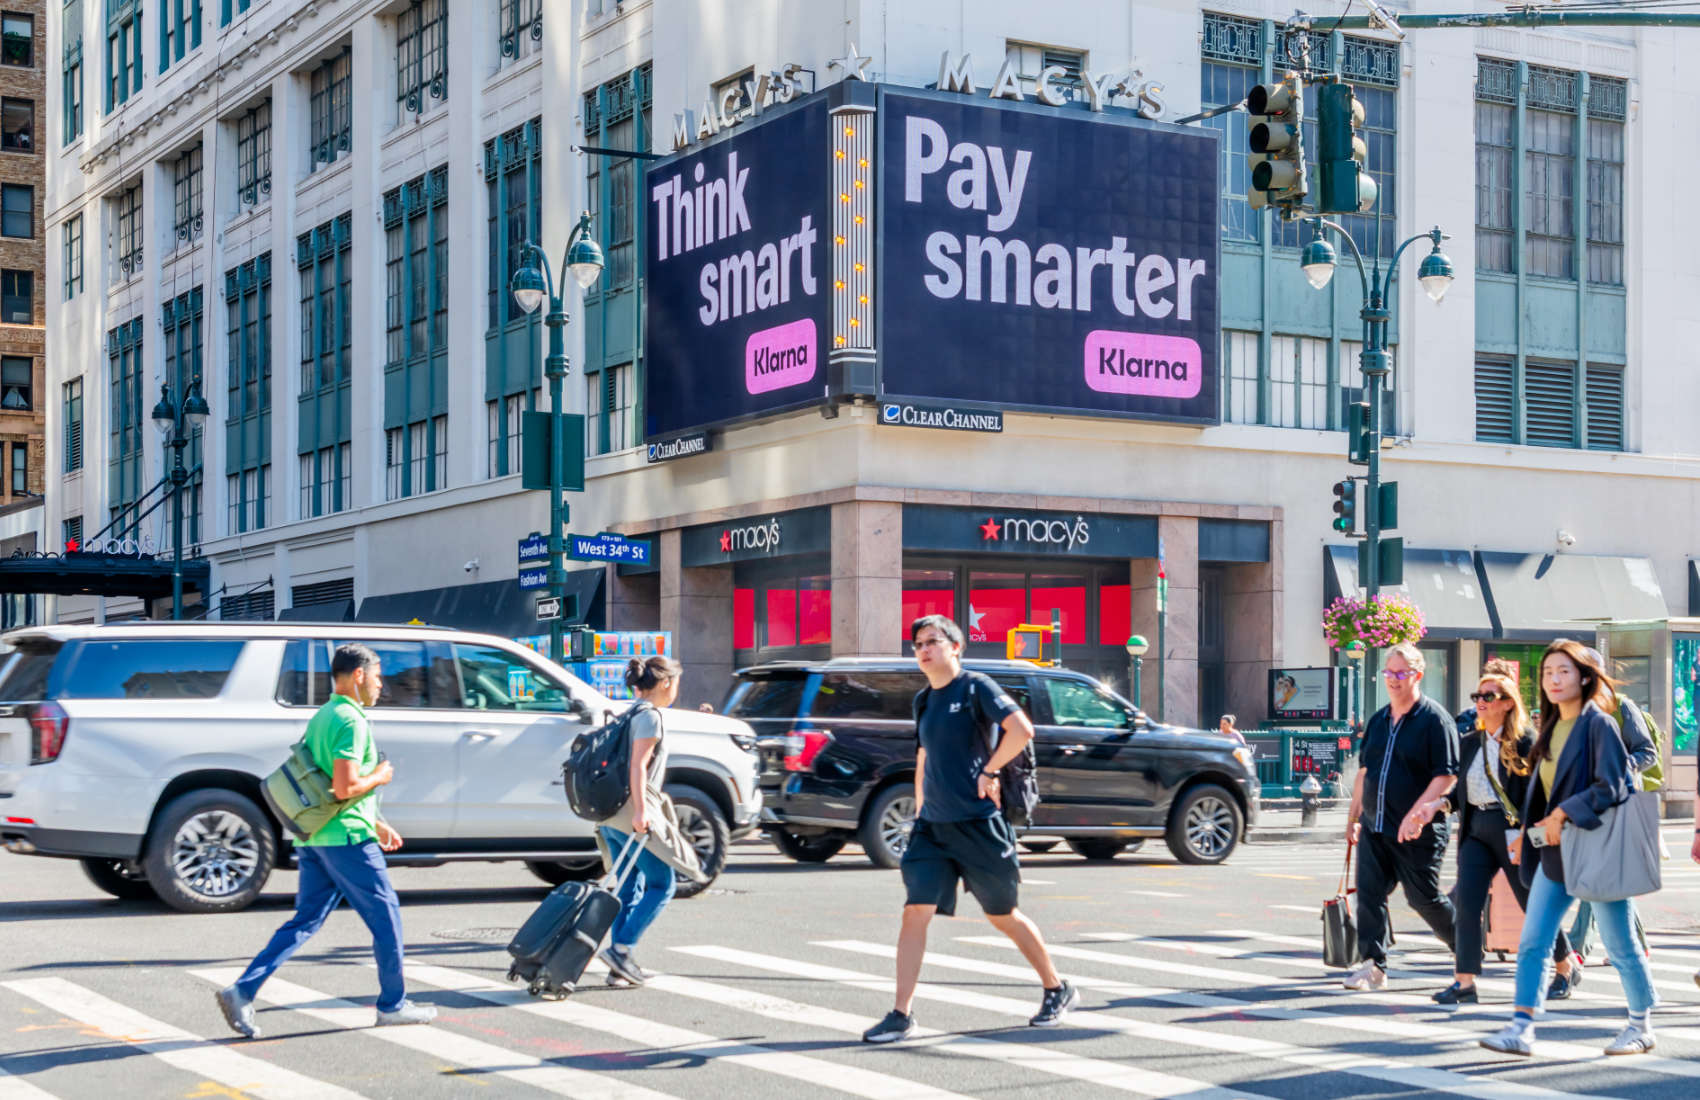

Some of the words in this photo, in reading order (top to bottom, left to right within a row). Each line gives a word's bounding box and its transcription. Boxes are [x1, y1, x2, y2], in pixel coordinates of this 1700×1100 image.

[905, 115, 1032, 233] Pay
[652, 151, 750, 261] Think
[698, 215, 817, 327] smart
[923, 230, 1206, 320] smarter
[754, 342, 808, 377] Klarna
[1099, 347, 1188, 382] Klarna
[83, 535, 156, 559] macy's
[578, 540, 607, 556] West
[608, 544, 630, 557] 34th
[632, 546, 644, 559] St
[730, 517, 780, 552] macy's
[1003, 515, 1090, 550] macy's
[520, 573, 538, 586] Fashion
